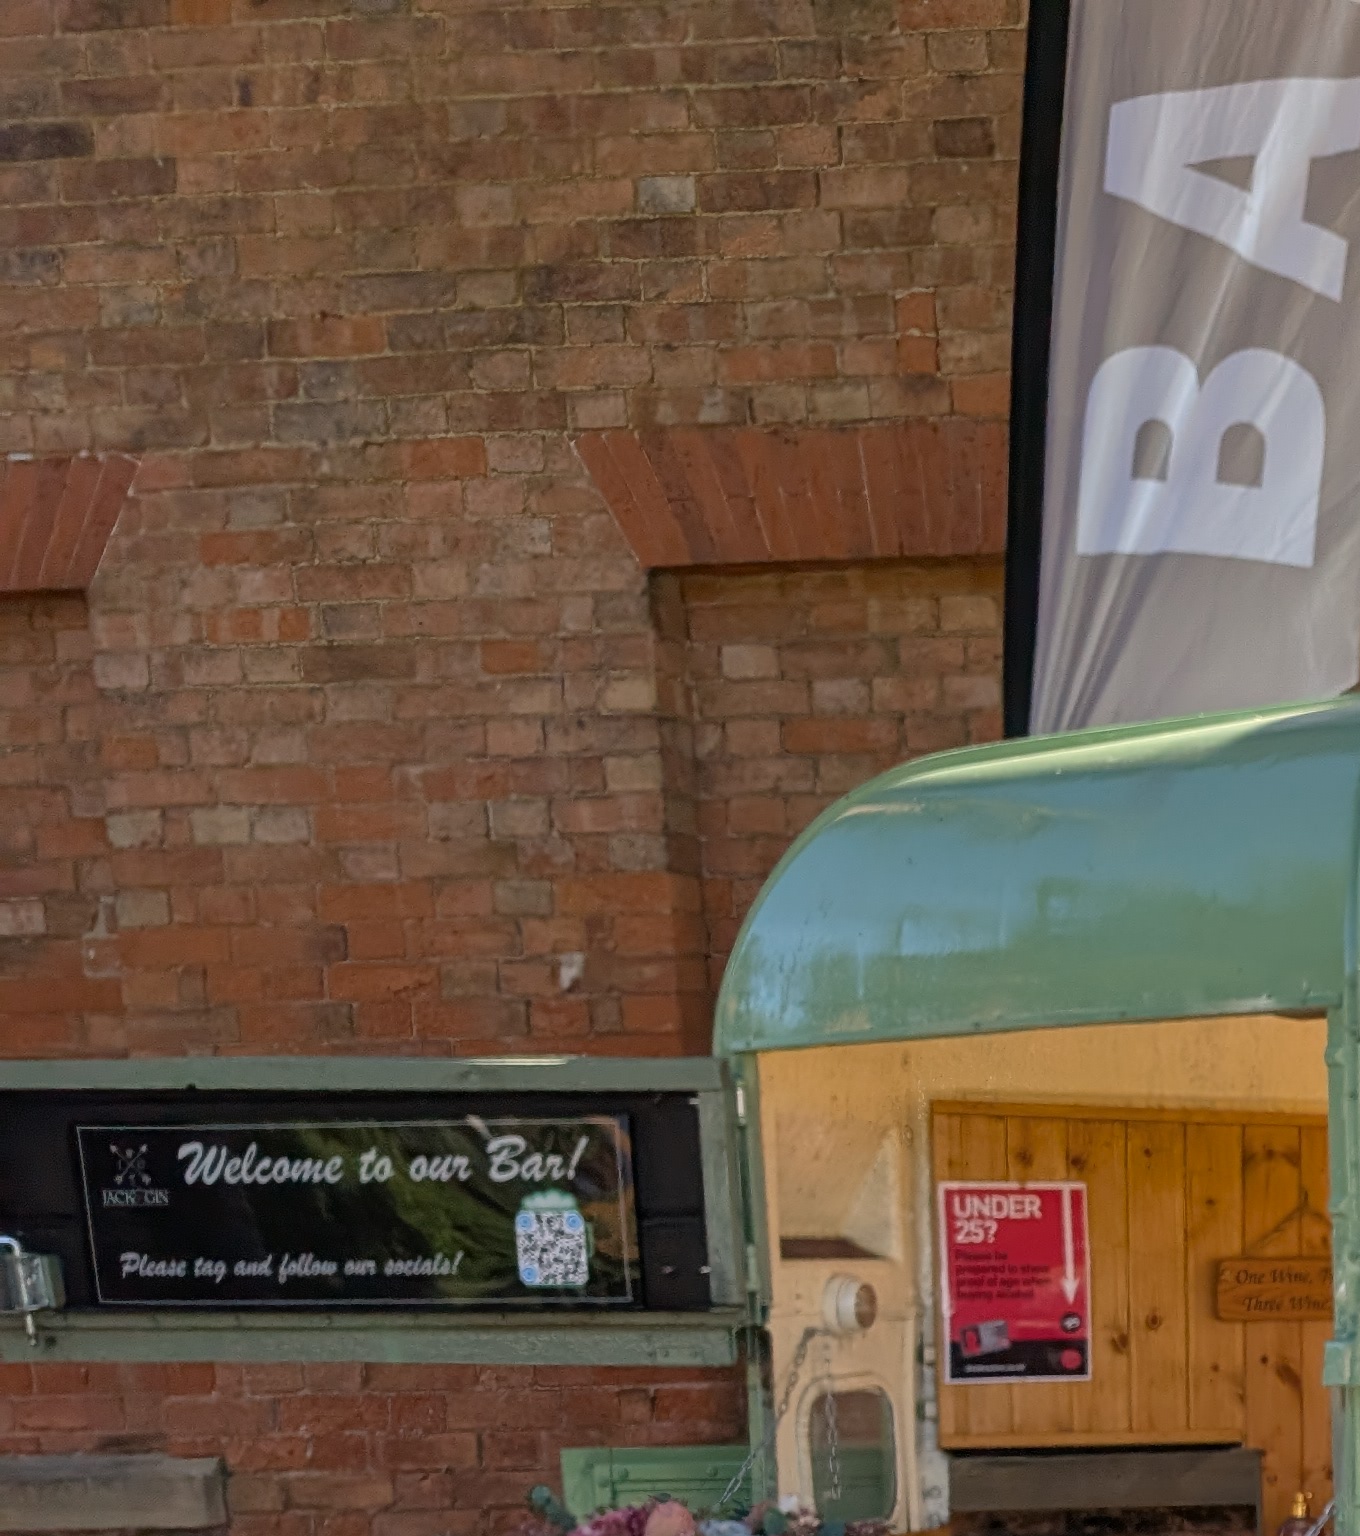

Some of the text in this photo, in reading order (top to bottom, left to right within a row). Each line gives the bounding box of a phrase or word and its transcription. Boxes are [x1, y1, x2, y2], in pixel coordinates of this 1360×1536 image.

[178, 1134, 590, 1186] Welcome to our Bar!
[953, 1194, 1042, 1220] UNDER
[954, 1219, 998, 1244] 25?
[120, 1250, 465, 1285] Please tag and follow our socials!
[1235, 1269, 1265, 1284] One
[1243, 1296, 1281, 1312] Three
